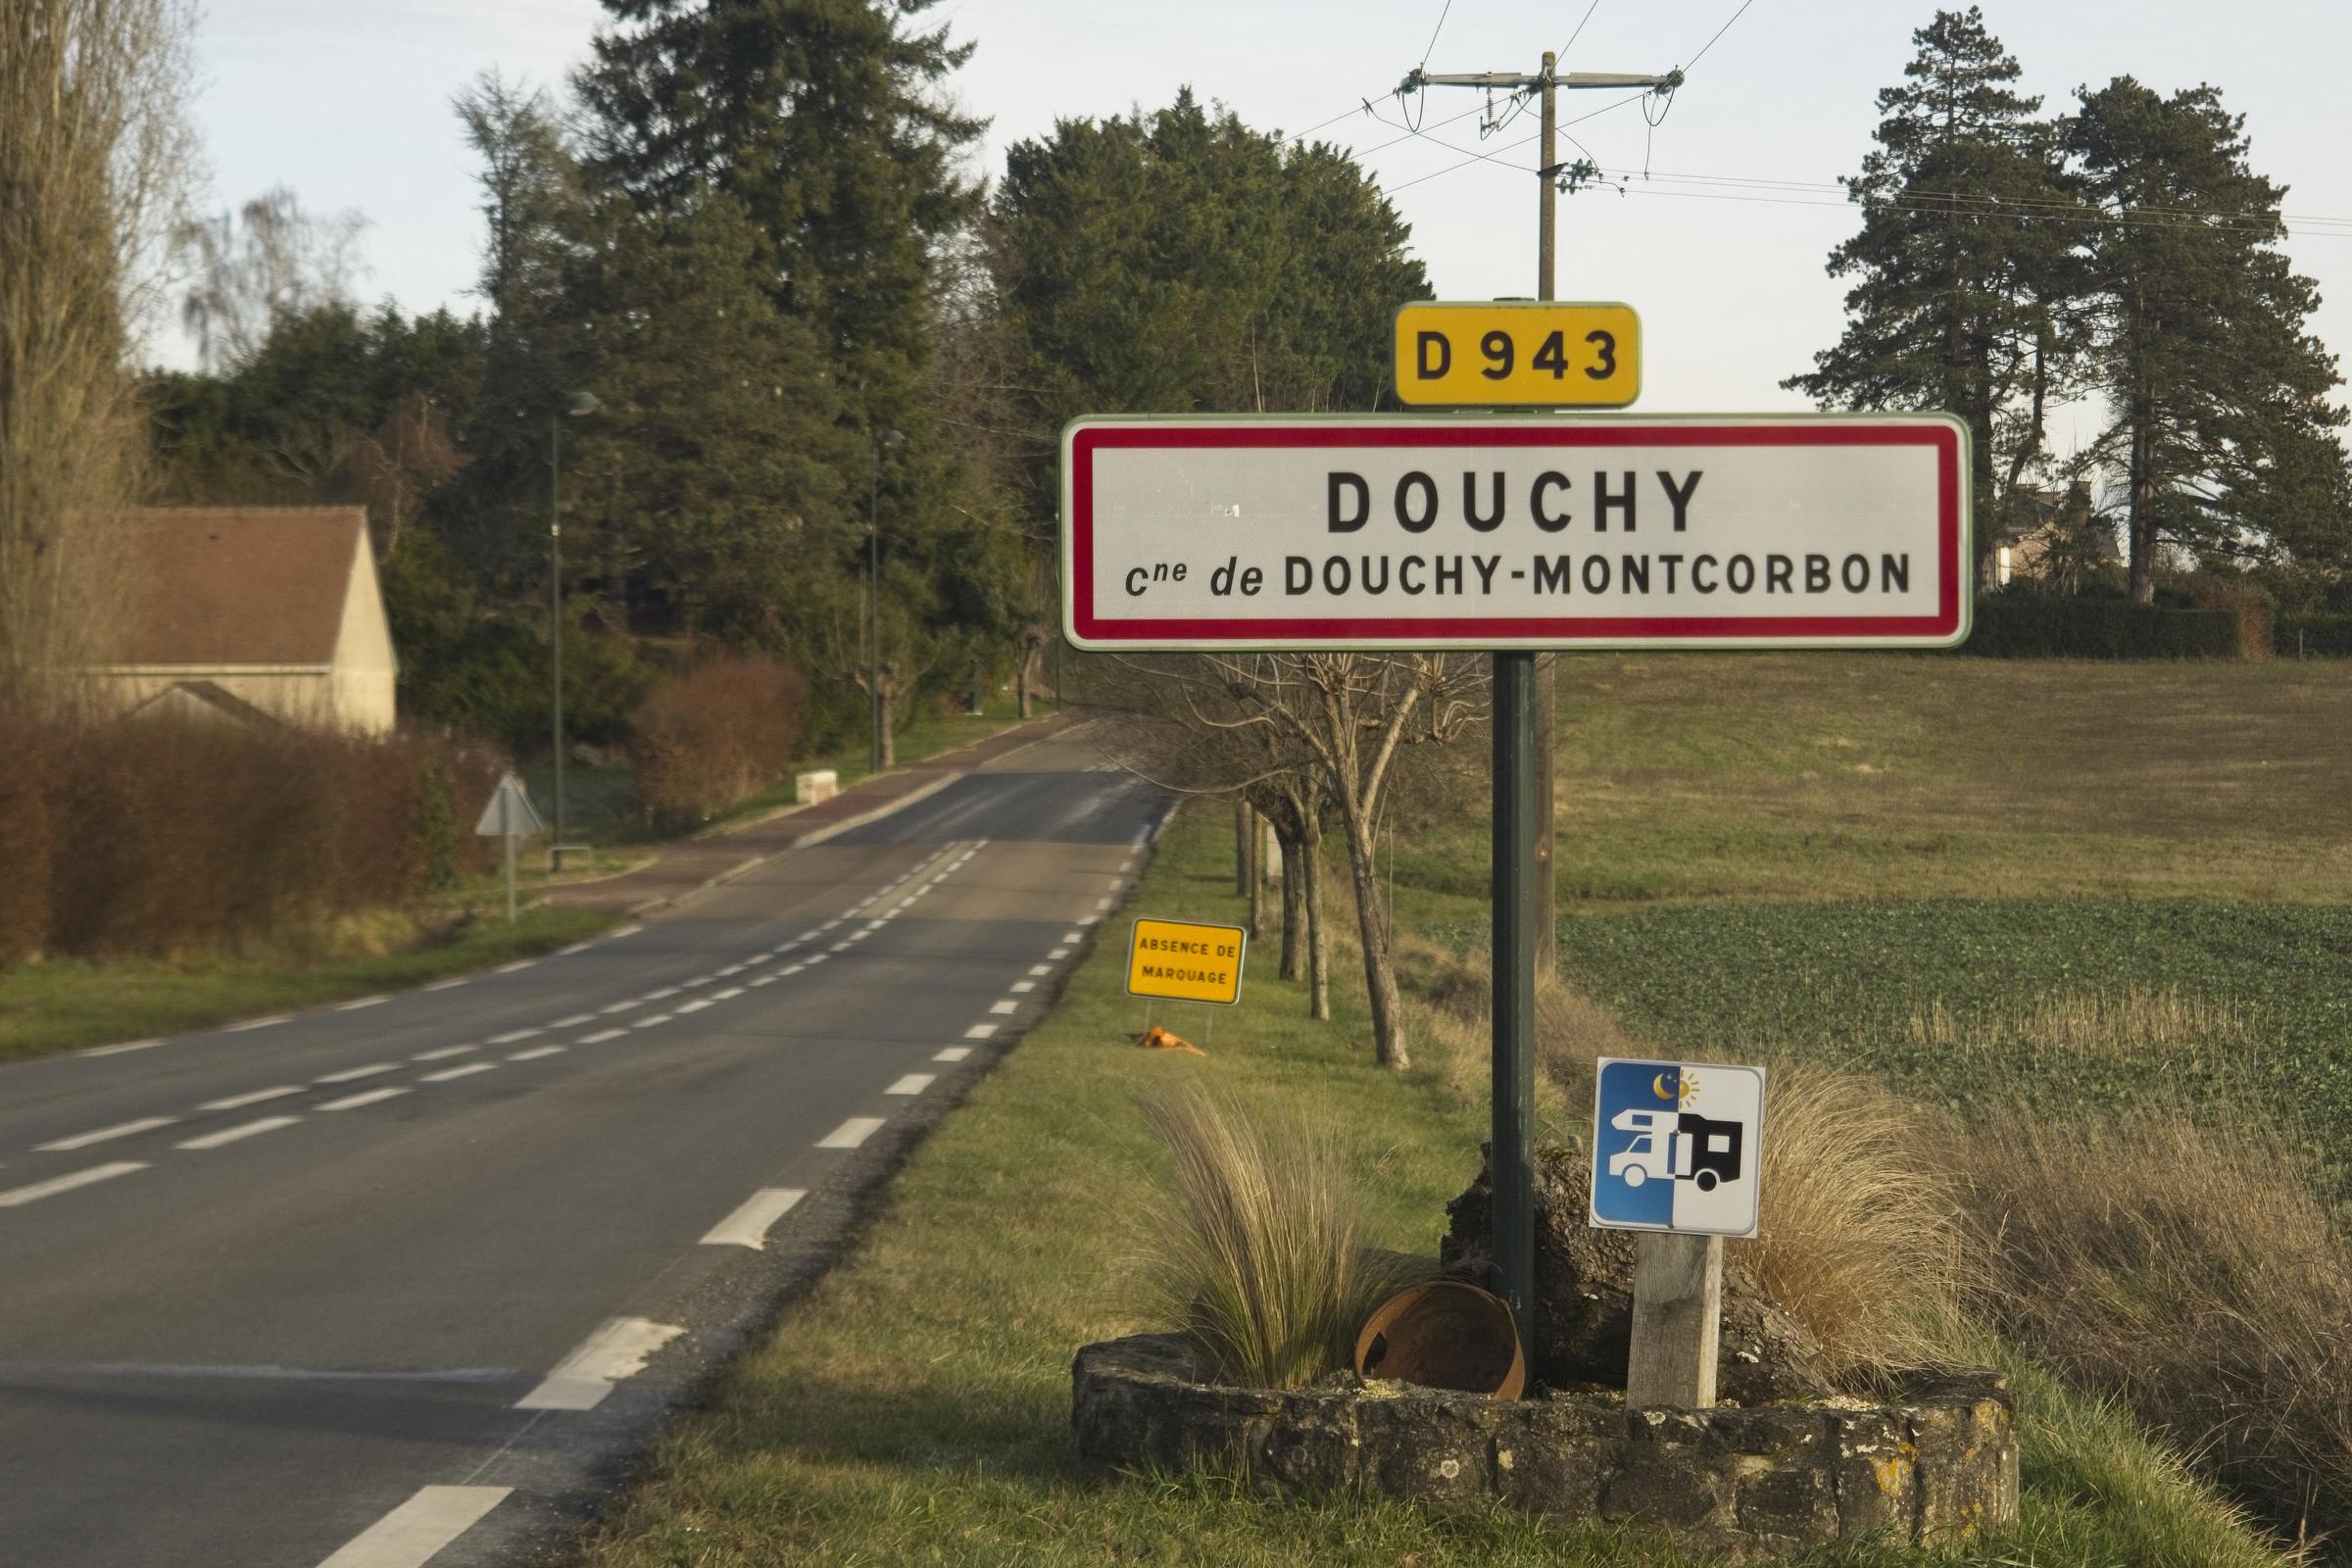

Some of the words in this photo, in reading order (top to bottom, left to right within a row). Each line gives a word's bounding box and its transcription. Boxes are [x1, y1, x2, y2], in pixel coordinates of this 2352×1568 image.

[1416, 330, 1451, 380] D
[1480, 329, 1617, 380] 943
[1327, 469, 1704, 533] DOUCHY
[1209, 556, 1263, 597] de
[1285, 553, 1909, 596] DOUCHY-MONTCORBON
[1139, 938, 1208, 956] ABSENCE
[1216, 945, 1236, 957] DE
[1142, 965, 1227, 985] MARQUAGE
